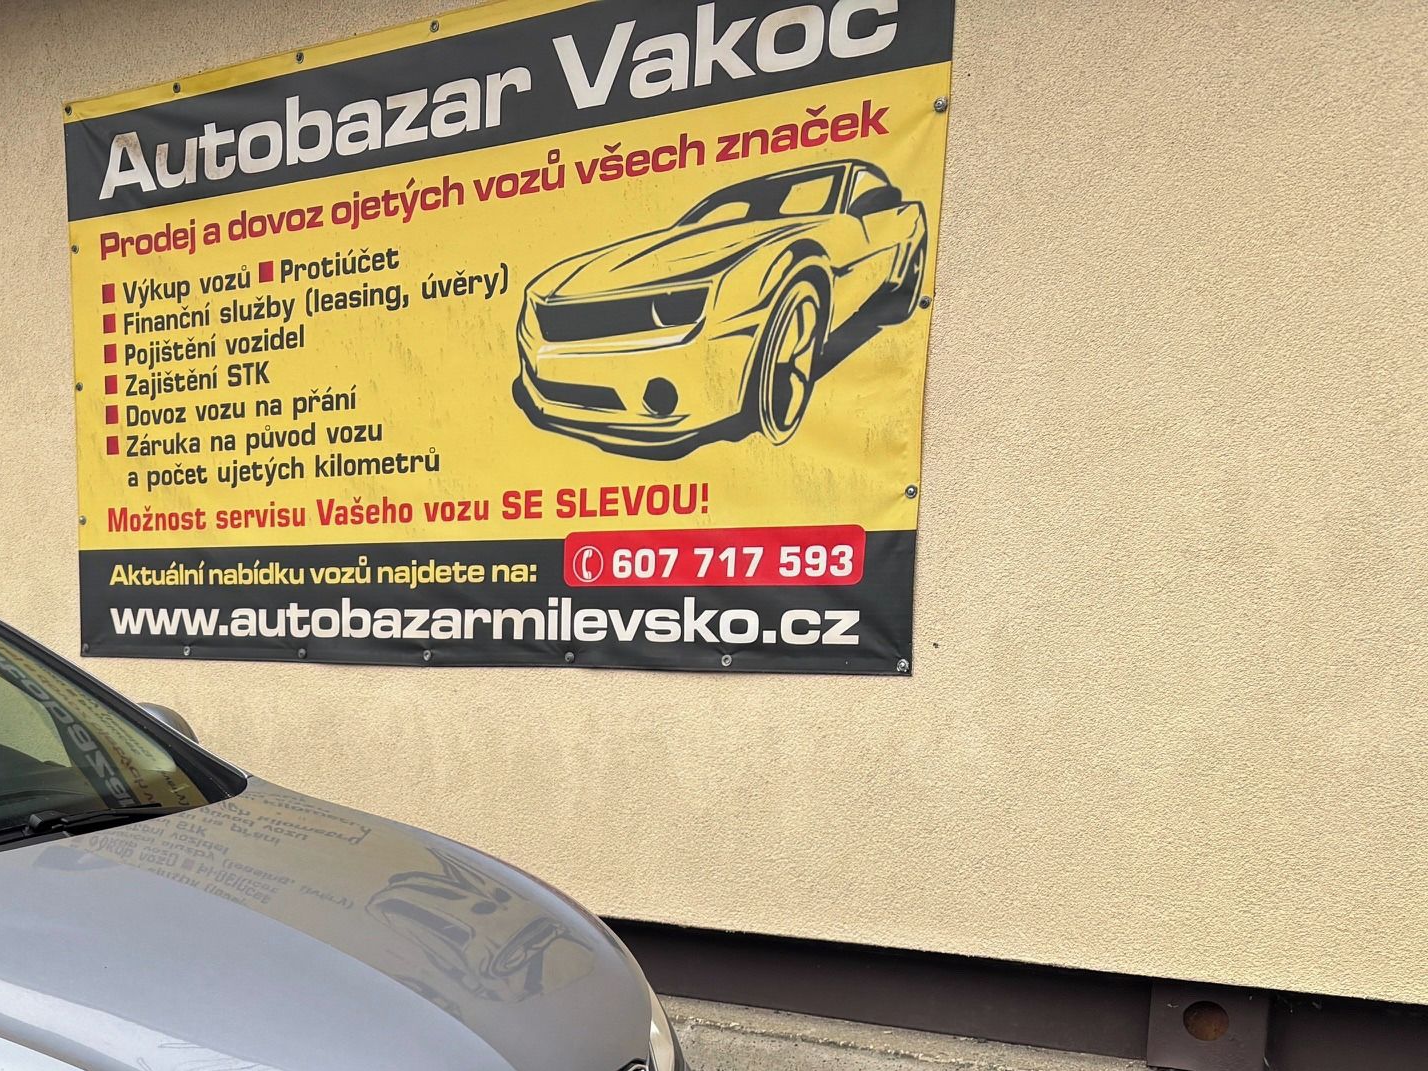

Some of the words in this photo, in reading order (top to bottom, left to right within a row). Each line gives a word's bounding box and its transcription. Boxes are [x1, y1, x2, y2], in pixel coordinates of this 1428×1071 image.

[99, 66, 532, 200] Autobazar
[552, 0, 898, 110] Vakoc
[100, 215, 196, 260] Prodej
[203, 223, 221, 247] a
[227, 205, 324, 242] dovoz
[331, 177, 465, 230] ojetých
[473, 149, 565, 202] vozů
[575, 133, 706, 185] všech
[716, 99, 891, 161] značek
[123, 277, 191, 308] Výkup
[199, 264, 251, 295] vozů
[280, 247, 400, 284] Protiúčet
[123, 304, 210, 336] Finanční
[220, 295, 296, 325] služby
[305, 282, 410, 317] (leasing,
[421, 262, 510, 301] úvěry)
[124, 333, 217, 369] Pojištění
[225, 324, 306, 357] vozidel
[125, 367, 219, 401] Zajištění
[227, 360, 271, 388] STK
[126, 404, 187, 428] Dovoz
[195, 400, 246, 422] vozu
[255, 398, 283, 418] na
[292, 384, 358, 421] přání
[126, 432, 201, 458] Záruka
[210, 434, 236, 453] na
[245, 422, 316, 456] původ
[326, 423, 384, 445] vozu
[127, 469, 139, 488] a
[147, 462, 208, 492] počet
[217, 453, 305, 488] ujetých
[315, 446, 441, 478] kilometrů
[107, 504, 207, 533] Možnost
[216, 501, 307, 531] servisu
[316, 496, 414, 527] Vašeho
[424, 499, 490, 524] vozu
[502, 489, 544, 520] SE
[556, 482, 710, 518] SLEVOU!
[109, 560, 205, 587] Aktuální
[209, 558, 305, 586] nabídku
[310, 555, 372, 585] vozů
[377, 559, 485, 590] najdete
[491, 561, 539, 584] na:
[612, 547, 679, 579] 607
[693, 546, 765, 579] 717
[778, 544, 855, 578] 593
[110, 596, 861, 646] www.autobazarmilevsko.cz
